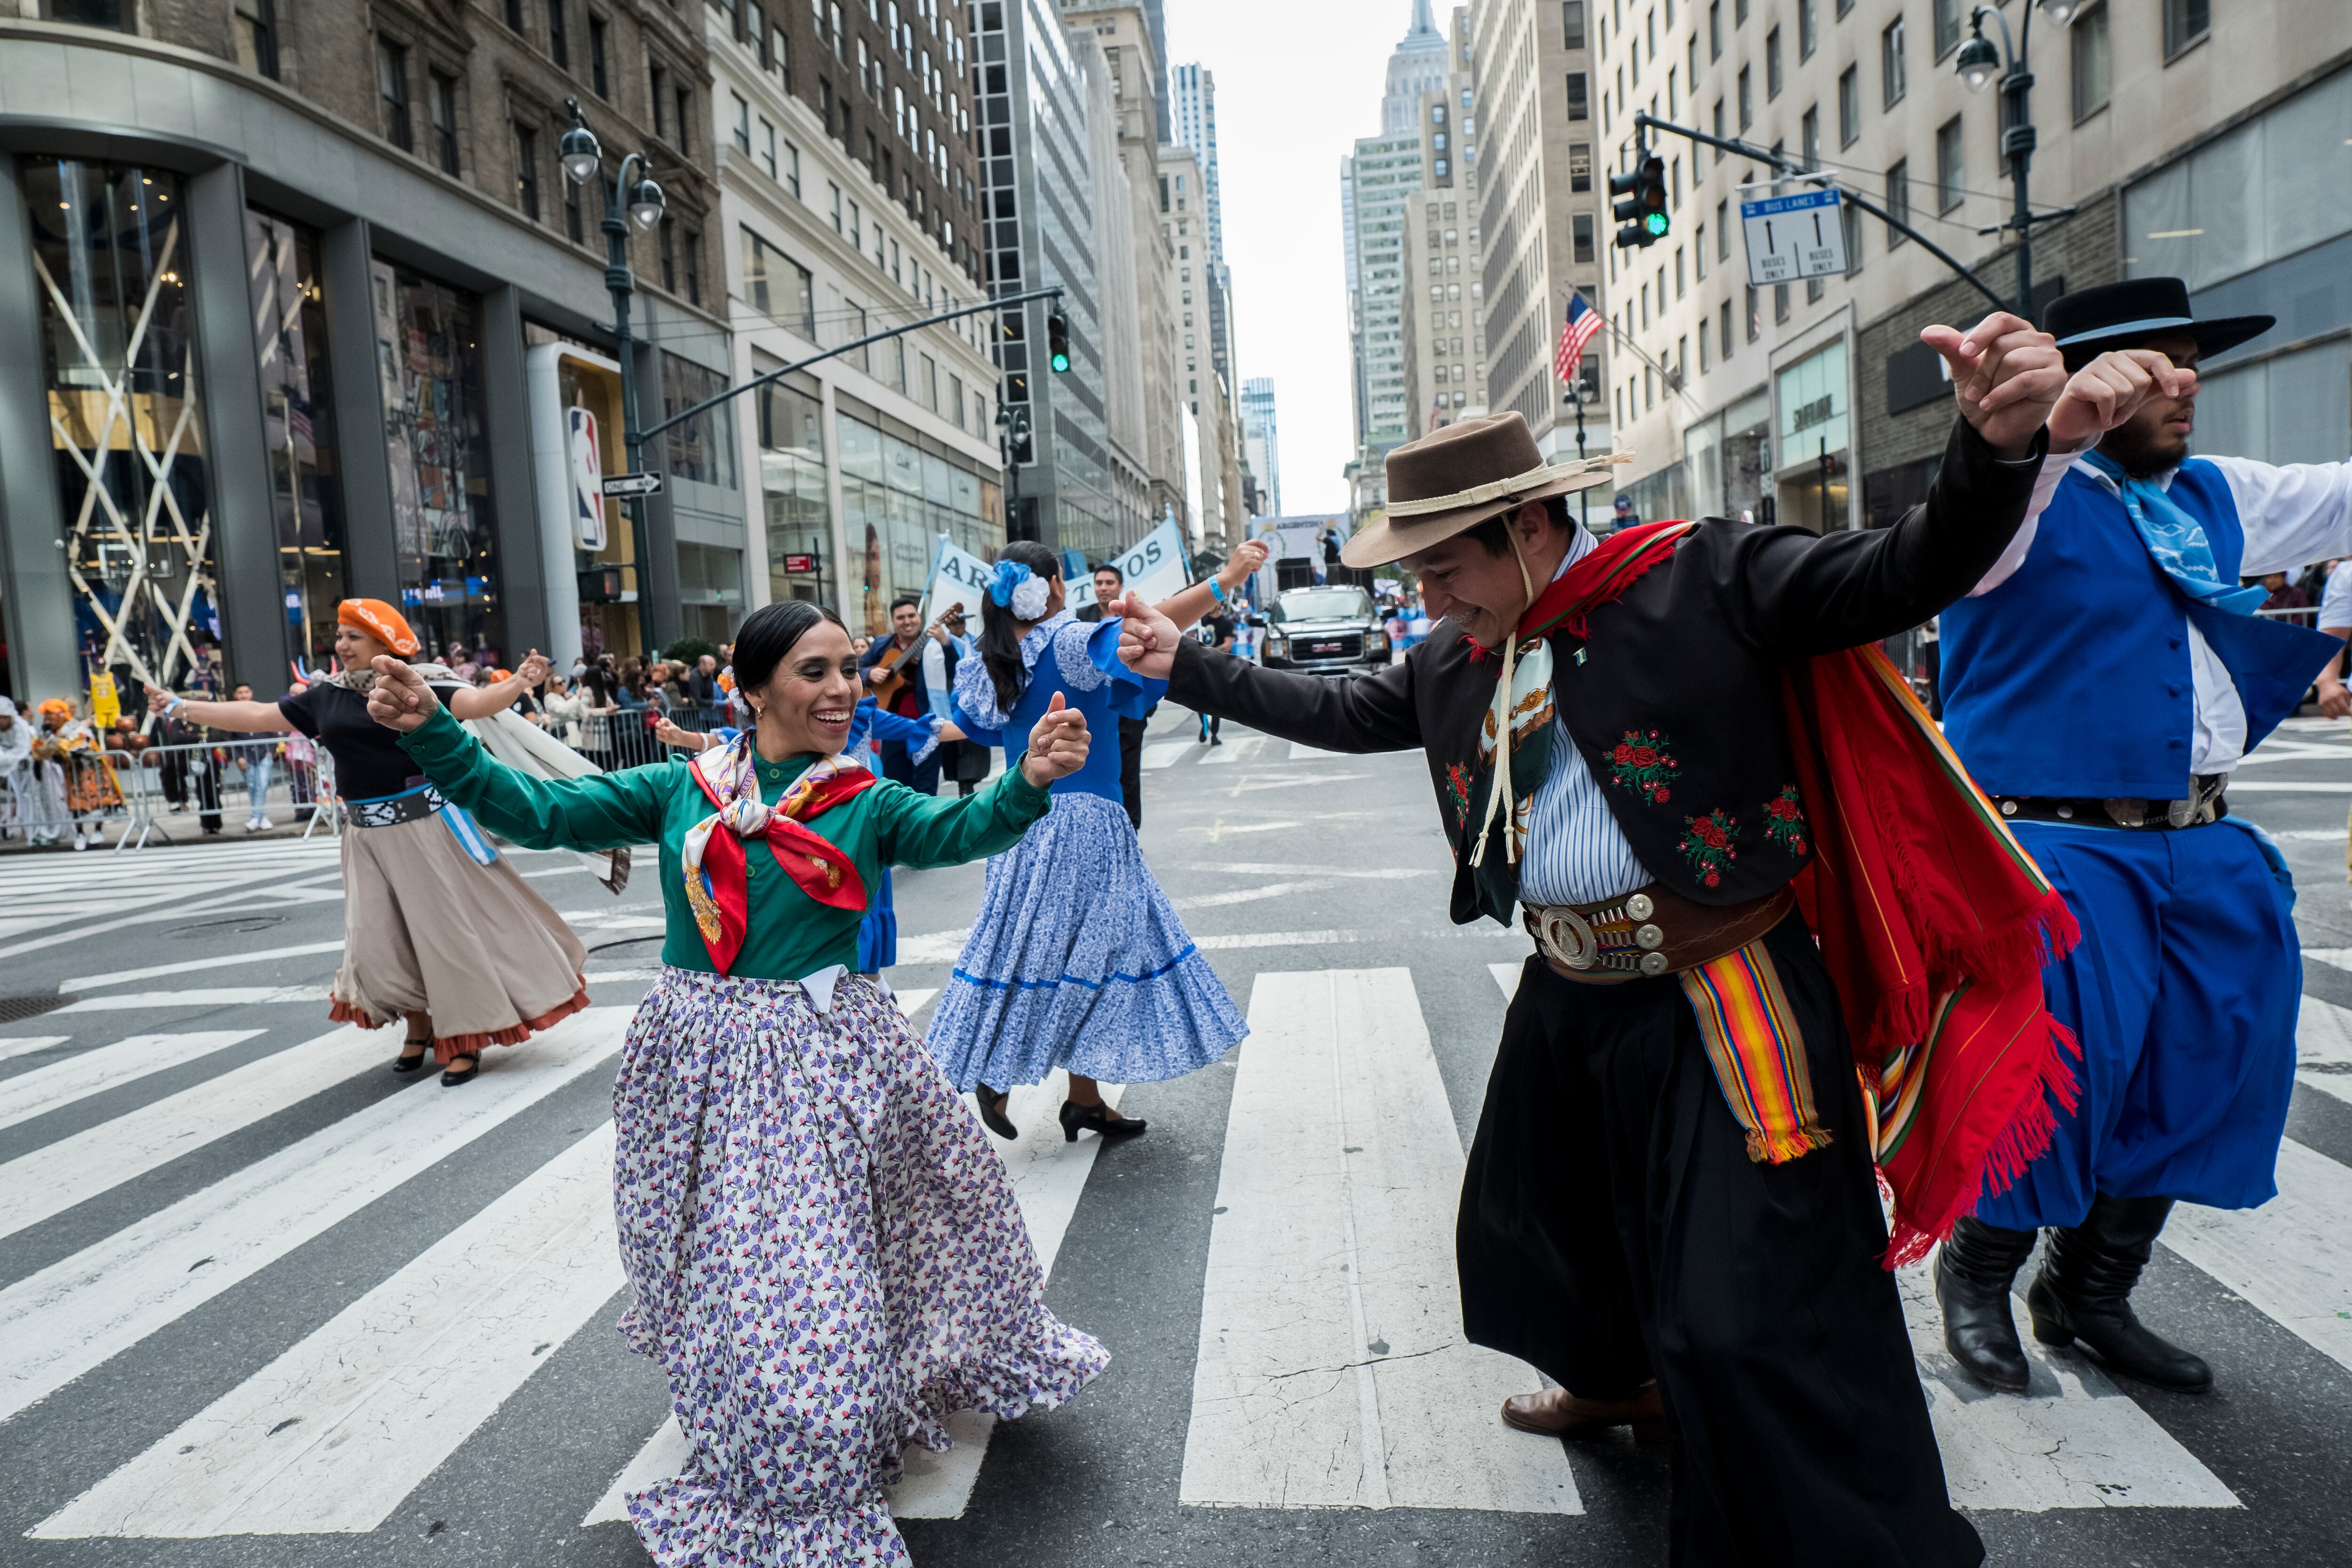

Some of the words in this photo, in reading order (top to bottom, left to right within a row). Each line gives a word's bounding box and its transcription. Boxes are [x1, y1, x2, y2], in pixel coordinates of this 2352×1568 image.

[1765, 202, 1783, 212] BUS
[1786, 195, 1816, 209] LANES
[1809, 247, 1833, 261] BUSES
[1762, 256, 1786, 268] BUSES
[1813, 261, 1833, 272] ONLY
[1765, 269, 1785, 280] ONLY
[605, 481, 623, 493] ONE
[637, 479, 654, 488] WAY
[1312, 642, 1342, 653] GMC
